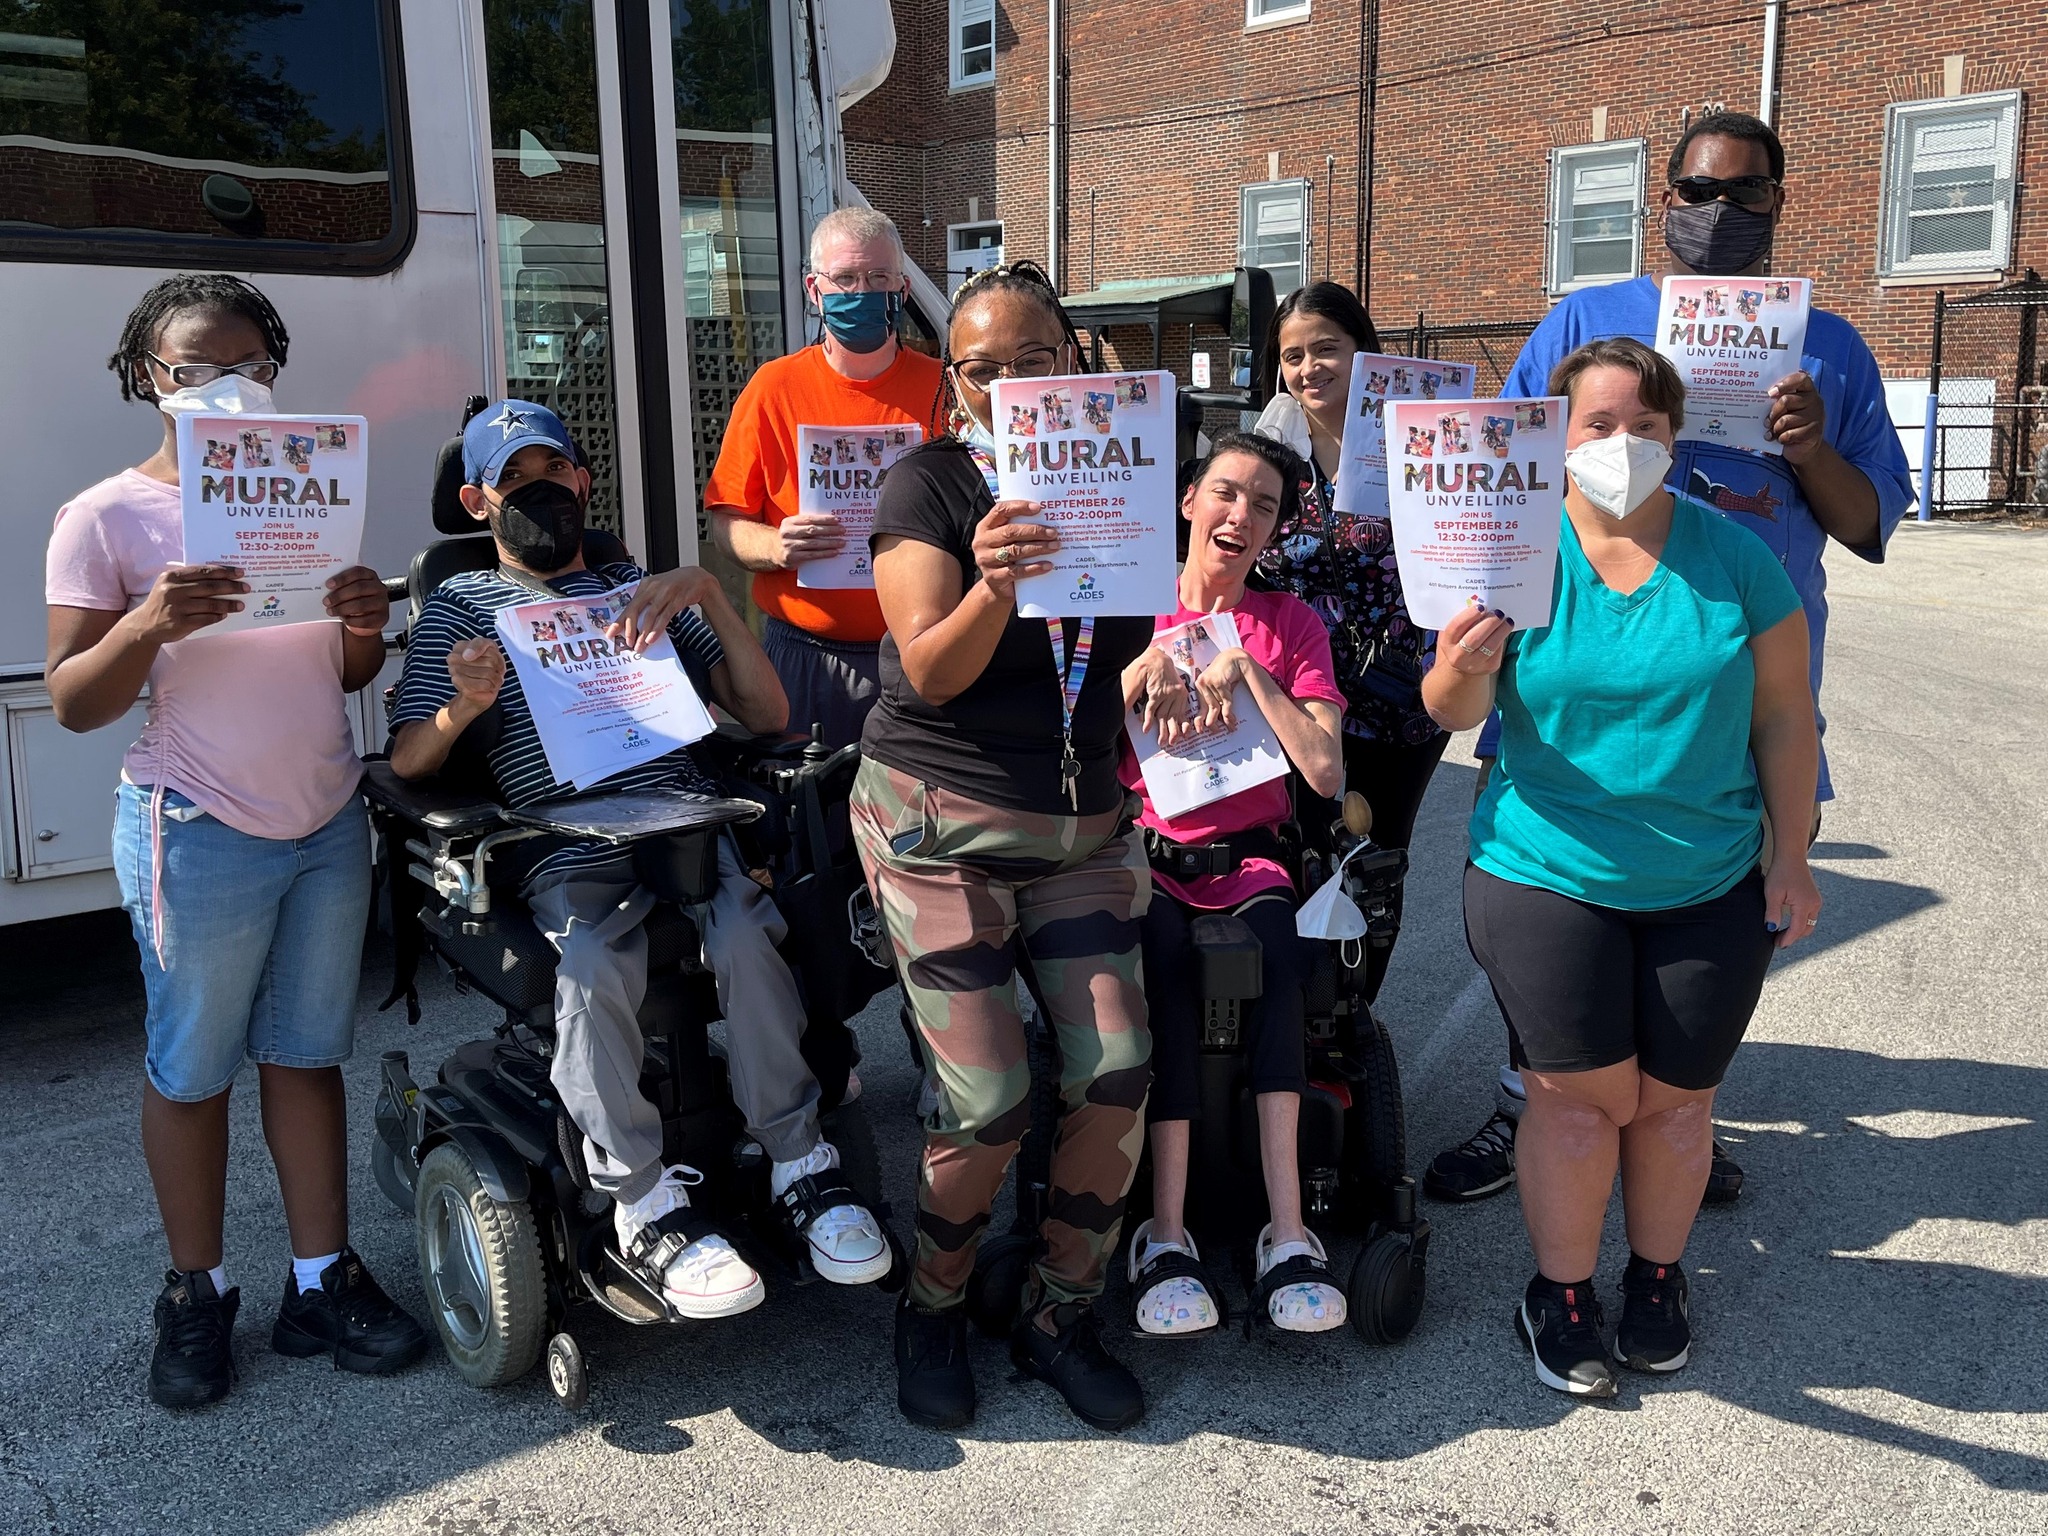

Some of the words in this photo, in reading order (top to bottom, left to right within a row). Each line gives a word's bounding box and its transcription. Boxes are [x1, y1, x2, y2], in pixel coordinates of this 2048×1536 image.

[1669, 324, 1789, 350] MURAL
[1687, 348, 1768, 360] UNVEILING
[1691, 368, 1745, 377] SEPTEMBER
[1693, 377, 1754, 387] 12:30-2:00pm
[1699, 428, 1728, 436] CADES
[1008, 437, 1155, 473] MURAL
[809, 468, 888, 490] MURA
[1031, 470, 1132, 486] UNVEILING
[1404, 461, 1549, 492] MURAL
[201, 475, 350, 506] MURAL
[825, 490, 881, 500] UNVEILI
[1040, 498, 1108, 510] SEPTEMBER
[1111, 497, 1126, 506] 26
[1426, 494, 1527, 506] UNVEILING
[227, 506, 328, 518] UNVEILING
[1044, 510, 1122, 521] 12:30-2:00pm
[1459, 511, 1479, 519] JOIN
[1434, 521, 1502, 530] SEPTEMBER
[1505, 520, 1518, 530] 26
[235, 531, 304, 540] SEPTEMBER
[306, 531, 319, 540] 26
[1438, 532, 1515, 543] 12:30-2:00pm
[239, 542, 315, 551] 12:30-2:00pm
[1069, 590, 1105, 600] CADES
[253, 609, 286, 618] CADES
[536, 634, 634, 668] MURA
[563, 652, 642, 674] UNVEILING
[577, 675, 630, 689] SEPTEMBER
[631, 671, 643, 680] 26
[583, 681, 644, 697] 12:30-2:00pm
[622, 738, 650, 749] CADES
[1204, 775, 1230, 790] CADES
